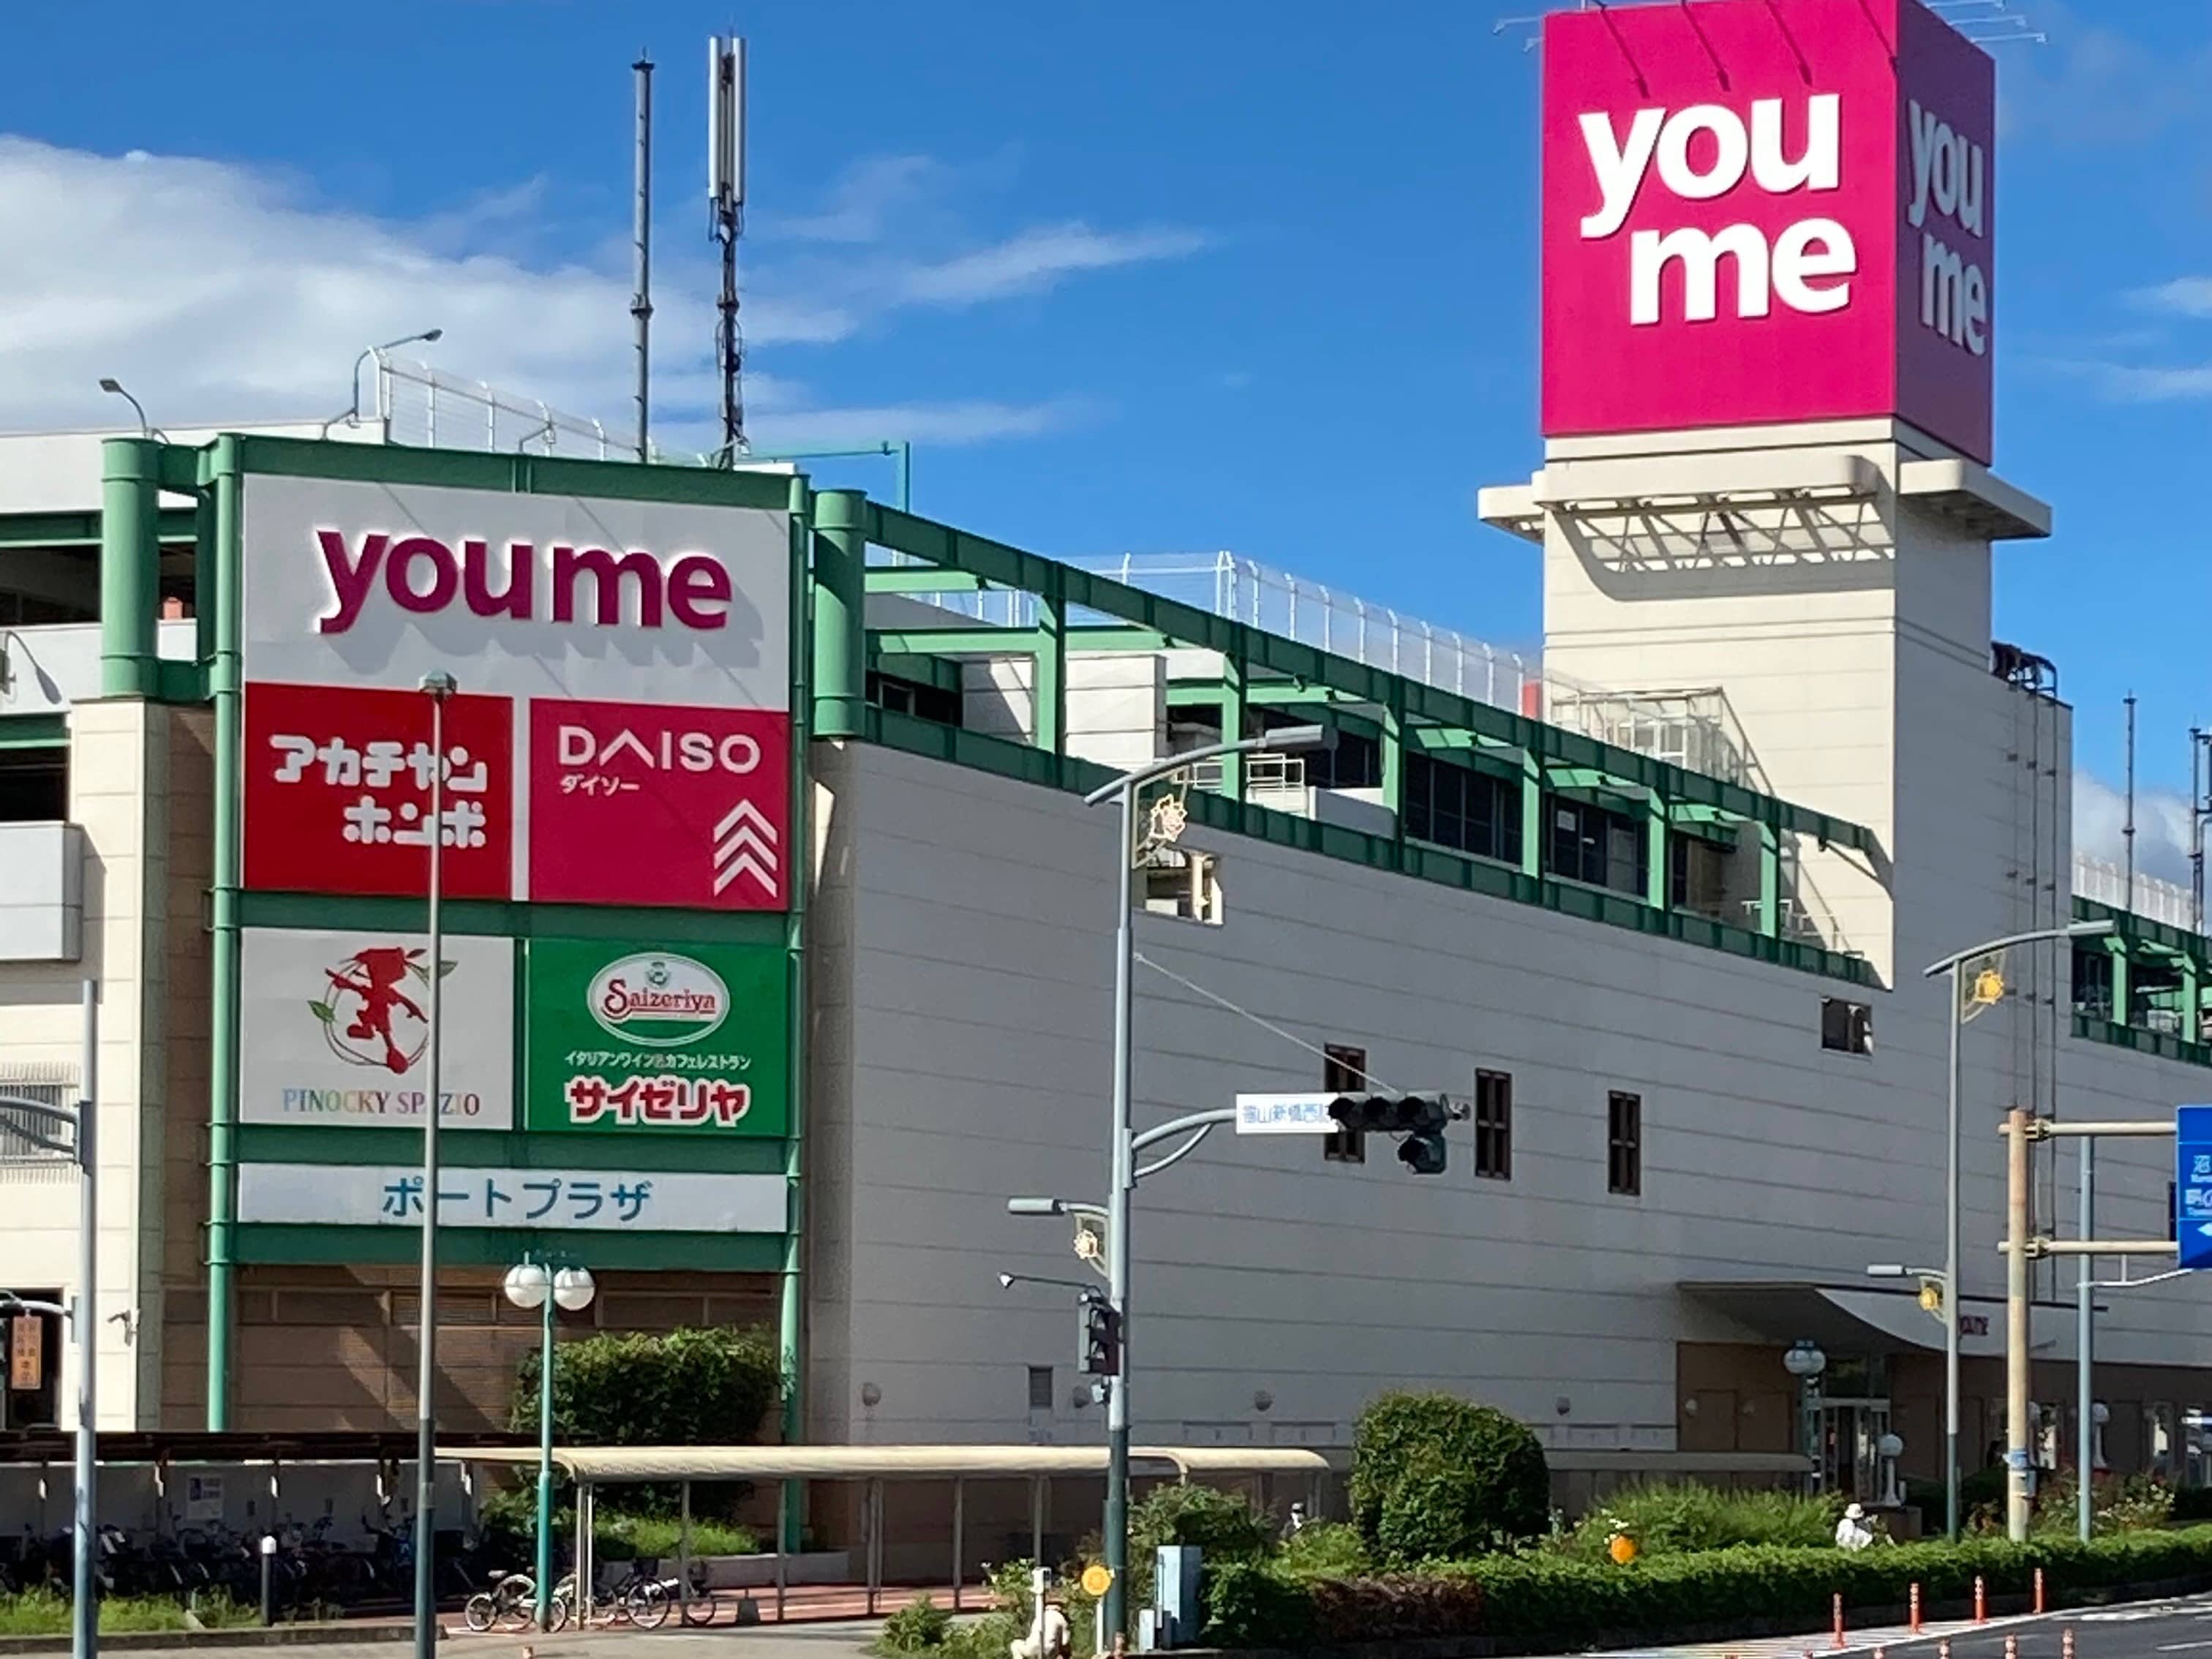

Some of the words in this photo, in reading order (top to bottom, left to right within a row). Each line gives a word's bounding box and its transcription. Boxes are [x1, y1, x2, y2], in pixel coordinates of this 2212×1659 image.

[1579, 94, 1840, 238] you
[1908, 100, 1983, 238] you
[1630, 218, 1856, 326] me
[1922, 233, 1986, 356] me
[316, 530, 731, 634] youme
[559, 725, 761, 774] DAISO
[560, 773, 640, 796] ダイソー
[342, 794, 486, 849] ホンポ
[603, 979, 716, 1014] Saizeriya
[282, 1088, 391, 1114] PINOCKY
[396, 1091, 480, 1116] SPZIO
[567, 1077, 749, 1125] サイゼリヤ
[383, 1175, 652, 1222] ポートプラザ
